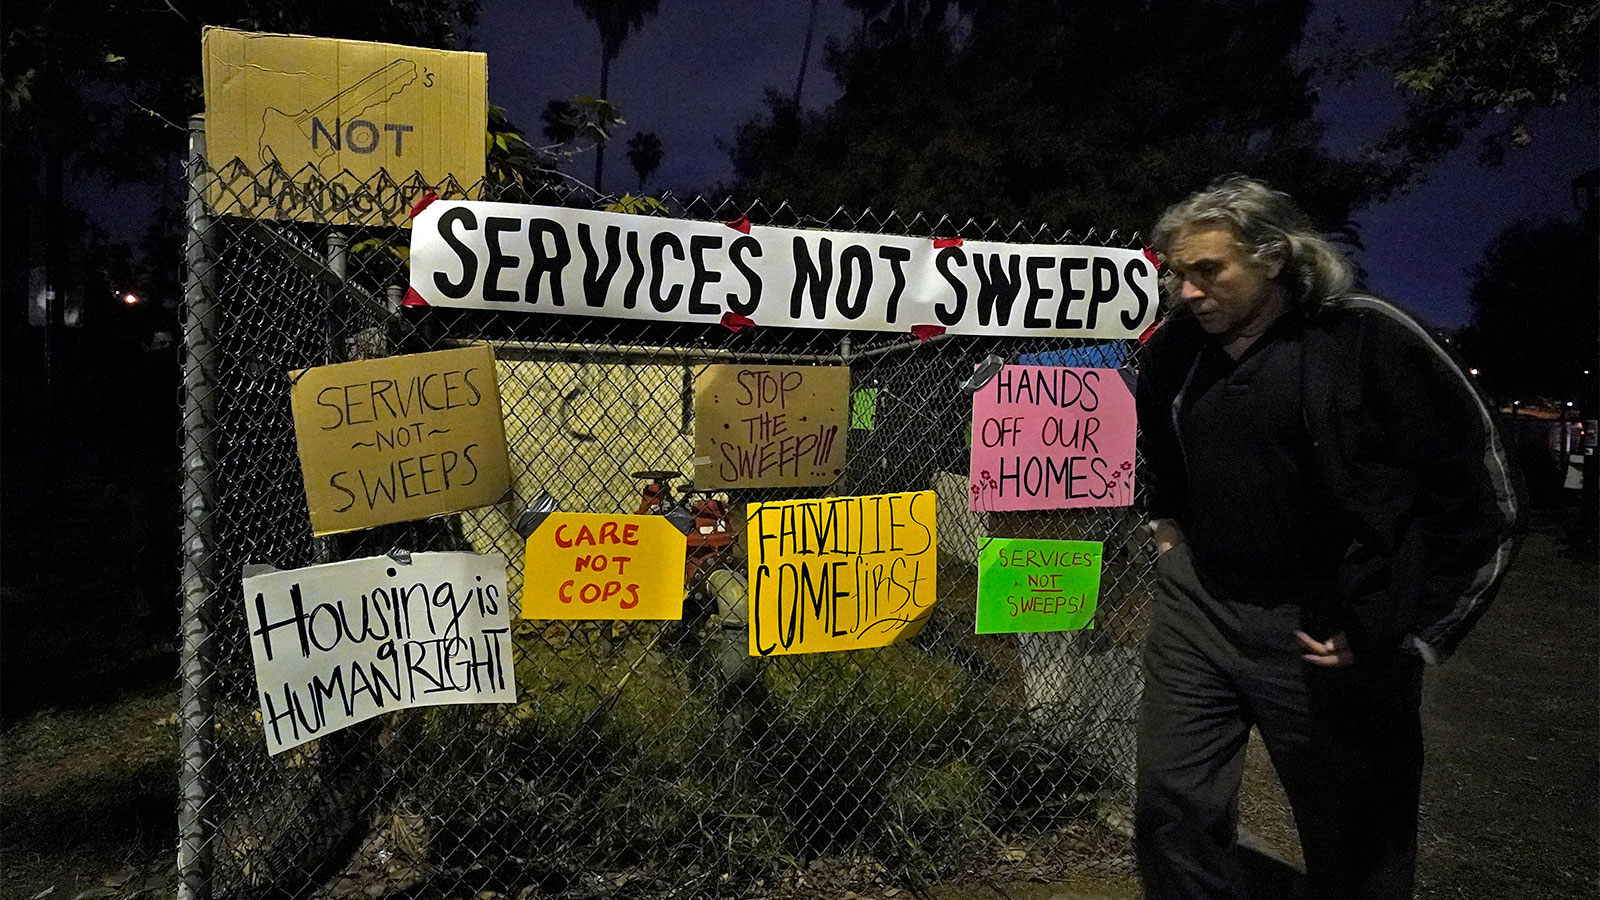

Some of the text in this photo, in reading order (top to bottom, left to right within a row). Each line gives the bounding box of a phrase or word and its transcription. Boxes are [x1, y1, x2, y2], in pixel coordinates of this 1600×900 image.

[311, 116, 414, 157] NOT
[433, 206, 1149, 331] SERVICES NOT SWEEPS
[316, 367, 482, 431] SERVICES
[735, 369, 803, 409] STOP
[997, 368, 1100, 412] HANDS
[741, 411, 788, 444] THE
[981, 416, 1100, 454] OFF OUR
[329, 443, 480, 513] SWEEPS
[999, 456, 1108, 500] HOMES
[554, 521, 640, 549] CARE
[757, 493, 932, 565] FAMILIES
[575, 554, 631, 575] NOT
[998, 547, 1093, 568] SERVICES
[475, 575, 499, 618] is
[558, 579, 640, 610] COPS
[1027, 574, 1064, 589] NOT
[754, 562, 850, 656] COME
[1006, 592, 1086, 617] SWEEPS!
[264, 627, 510, 746] HUMAN RIGHT
